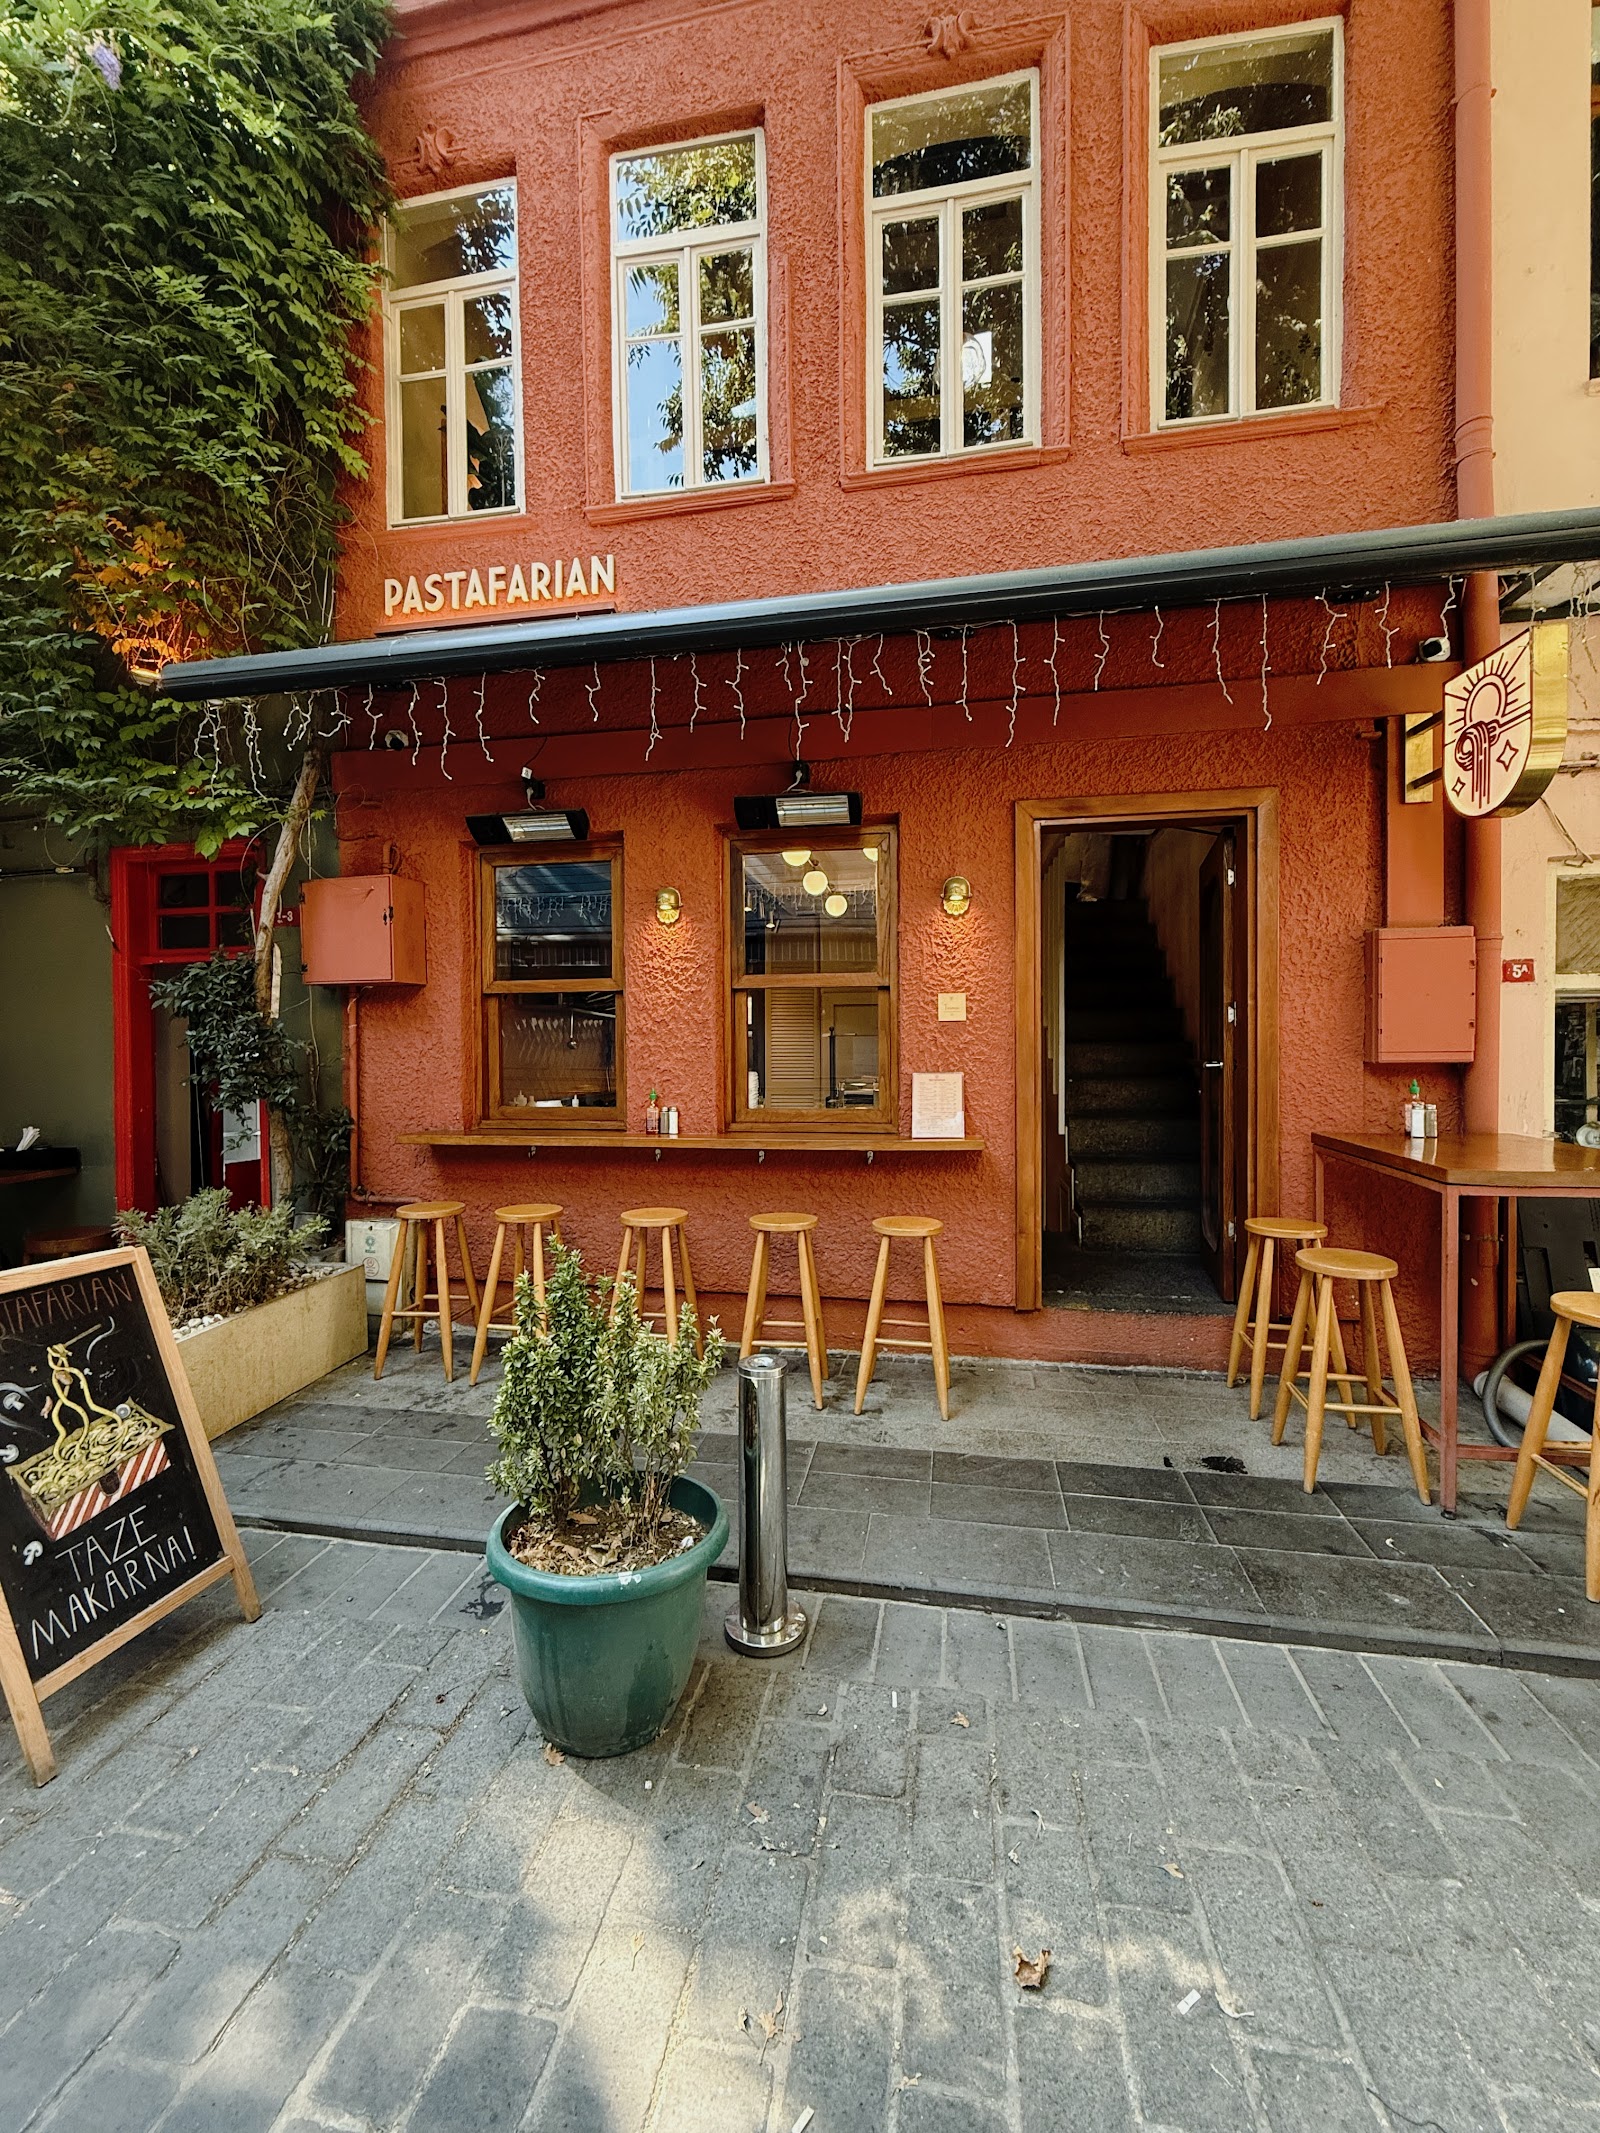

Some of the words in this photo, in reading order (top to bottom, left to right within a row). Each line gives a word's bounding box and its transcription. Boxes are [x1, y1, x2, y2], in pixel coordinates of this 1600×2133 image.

[384, 554, 615, 617] PASTAFARIAN
[55, 1505, 157, 1582] TAZE
[32, 1526, 197, 1660] MAKARNA!
